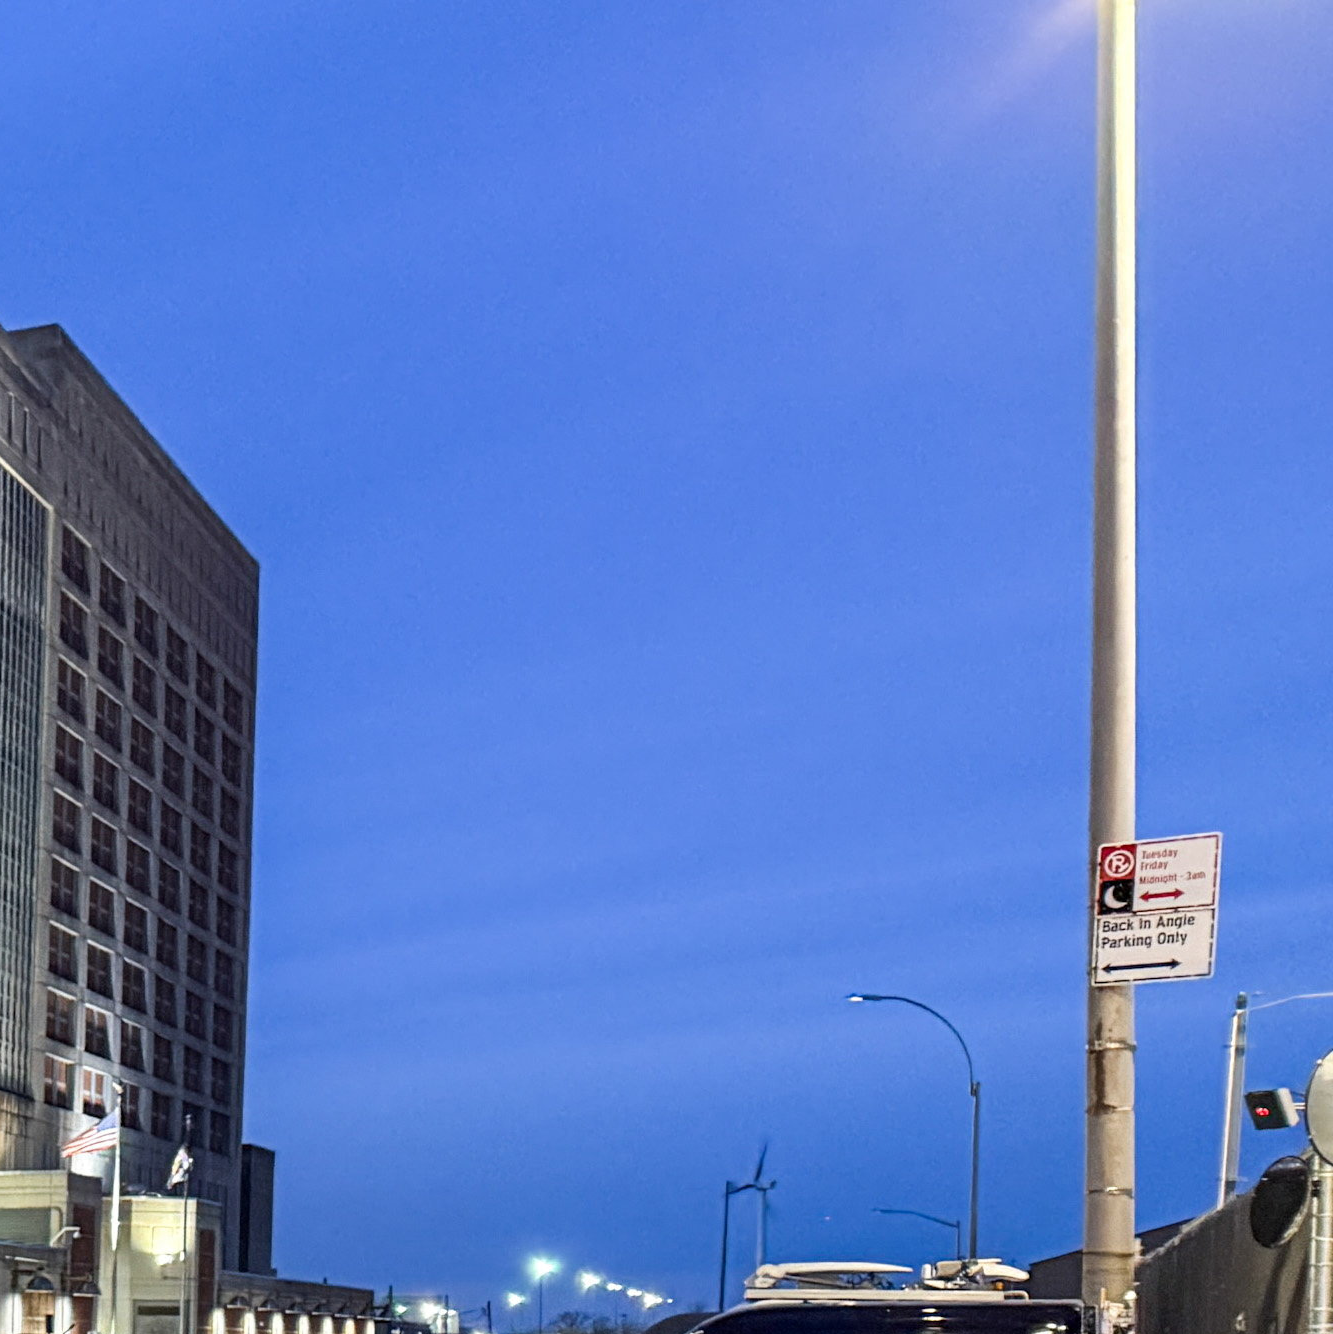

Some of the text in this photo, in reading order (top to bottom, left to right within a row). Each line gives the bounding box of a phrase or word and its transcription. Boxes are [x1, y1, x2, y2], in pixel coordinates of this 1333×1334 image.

[1142, 849, 1178, 860] Tuesday
[1140, 861, 1169, 871] Friday
[1139, 873, 1177, 884] Midnight
[1102, 914, 1195, 933] Back In Angle
[1101, 931, 1188, 949] Parking Only
